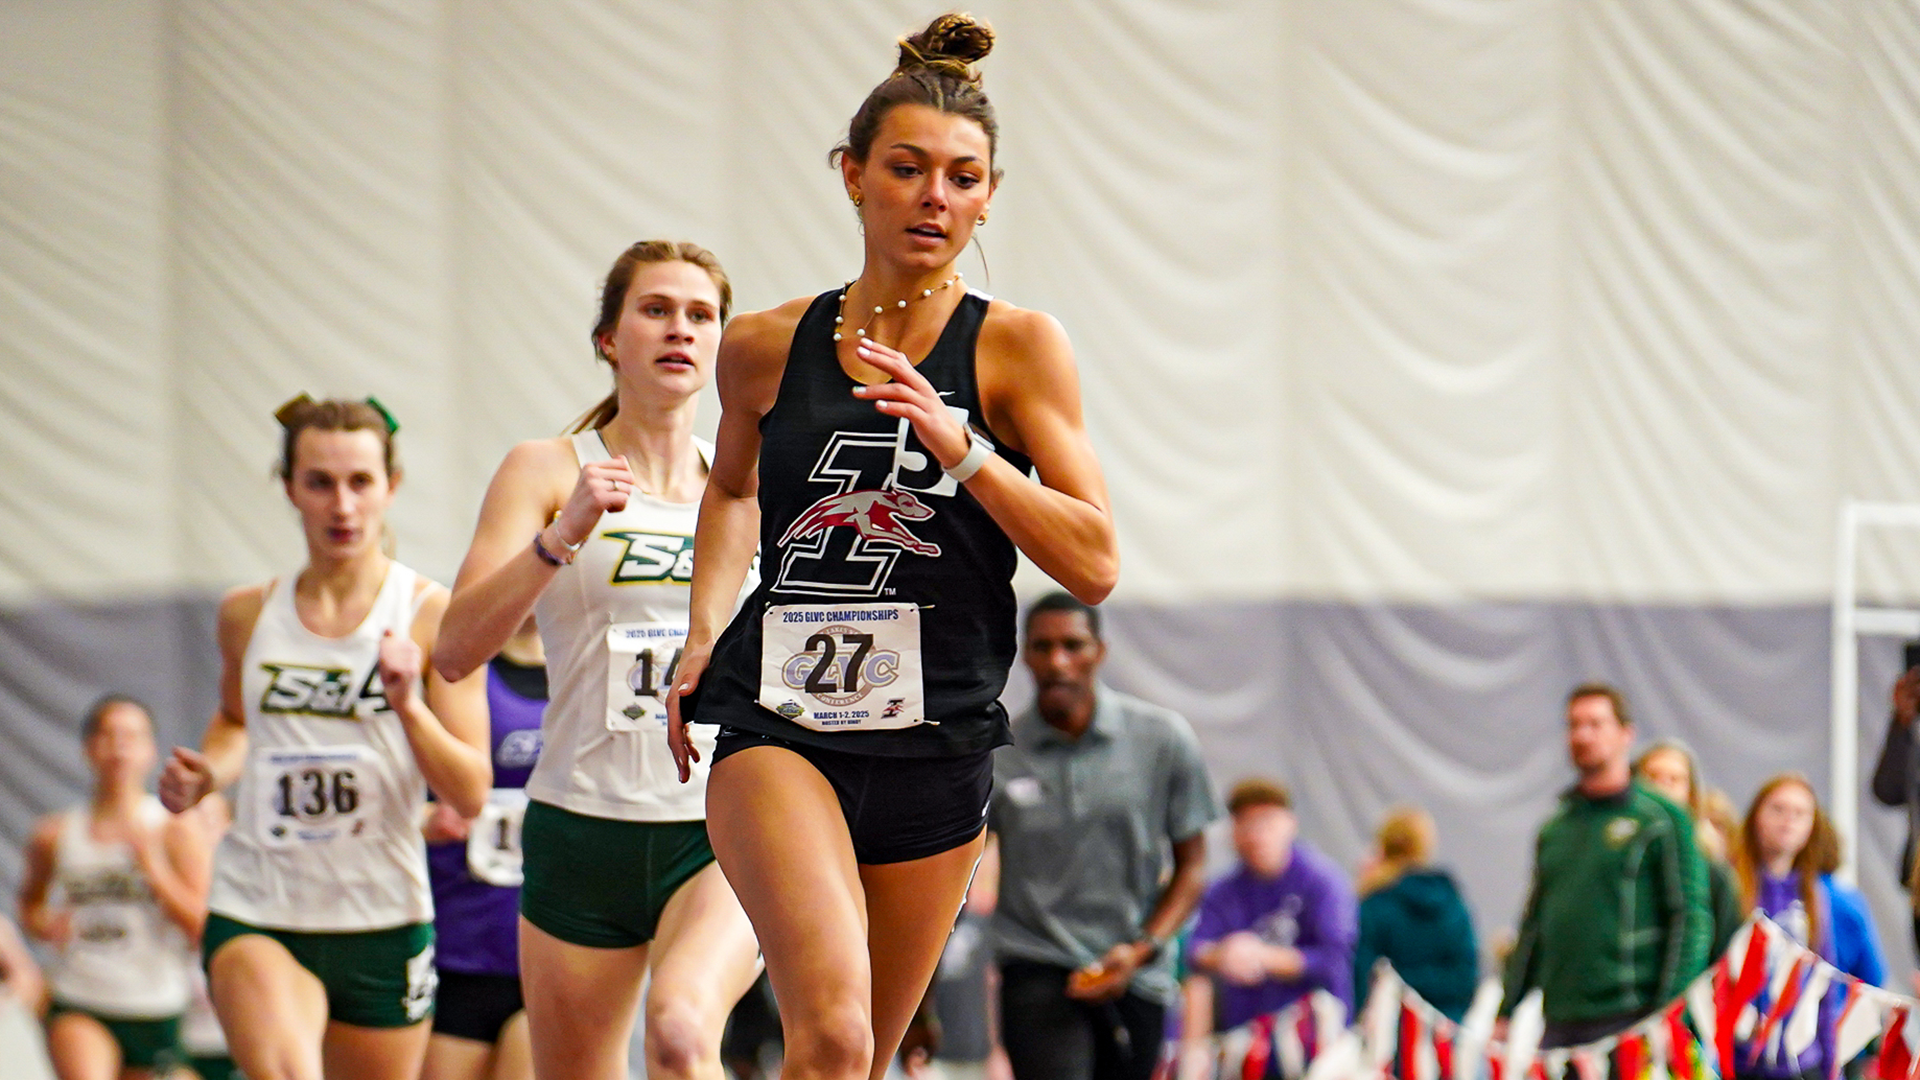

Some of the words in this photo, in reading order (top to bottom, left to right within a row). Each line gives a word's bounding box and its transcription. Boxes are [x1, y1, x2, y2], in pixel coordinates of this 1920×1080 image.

[884, 587, 897, 596] TM
[783, 611, 804, 623] 2025
[805, 612, 825, 623] GLVC
[826, 608, 899, 622] CHAMPIONSHIPS
[804, 633, 874, 693] 27
[814, 711, 838, 720] MARCH
[851, 710, 870, 718] 2025
[277, 768, 360, 818] 136
